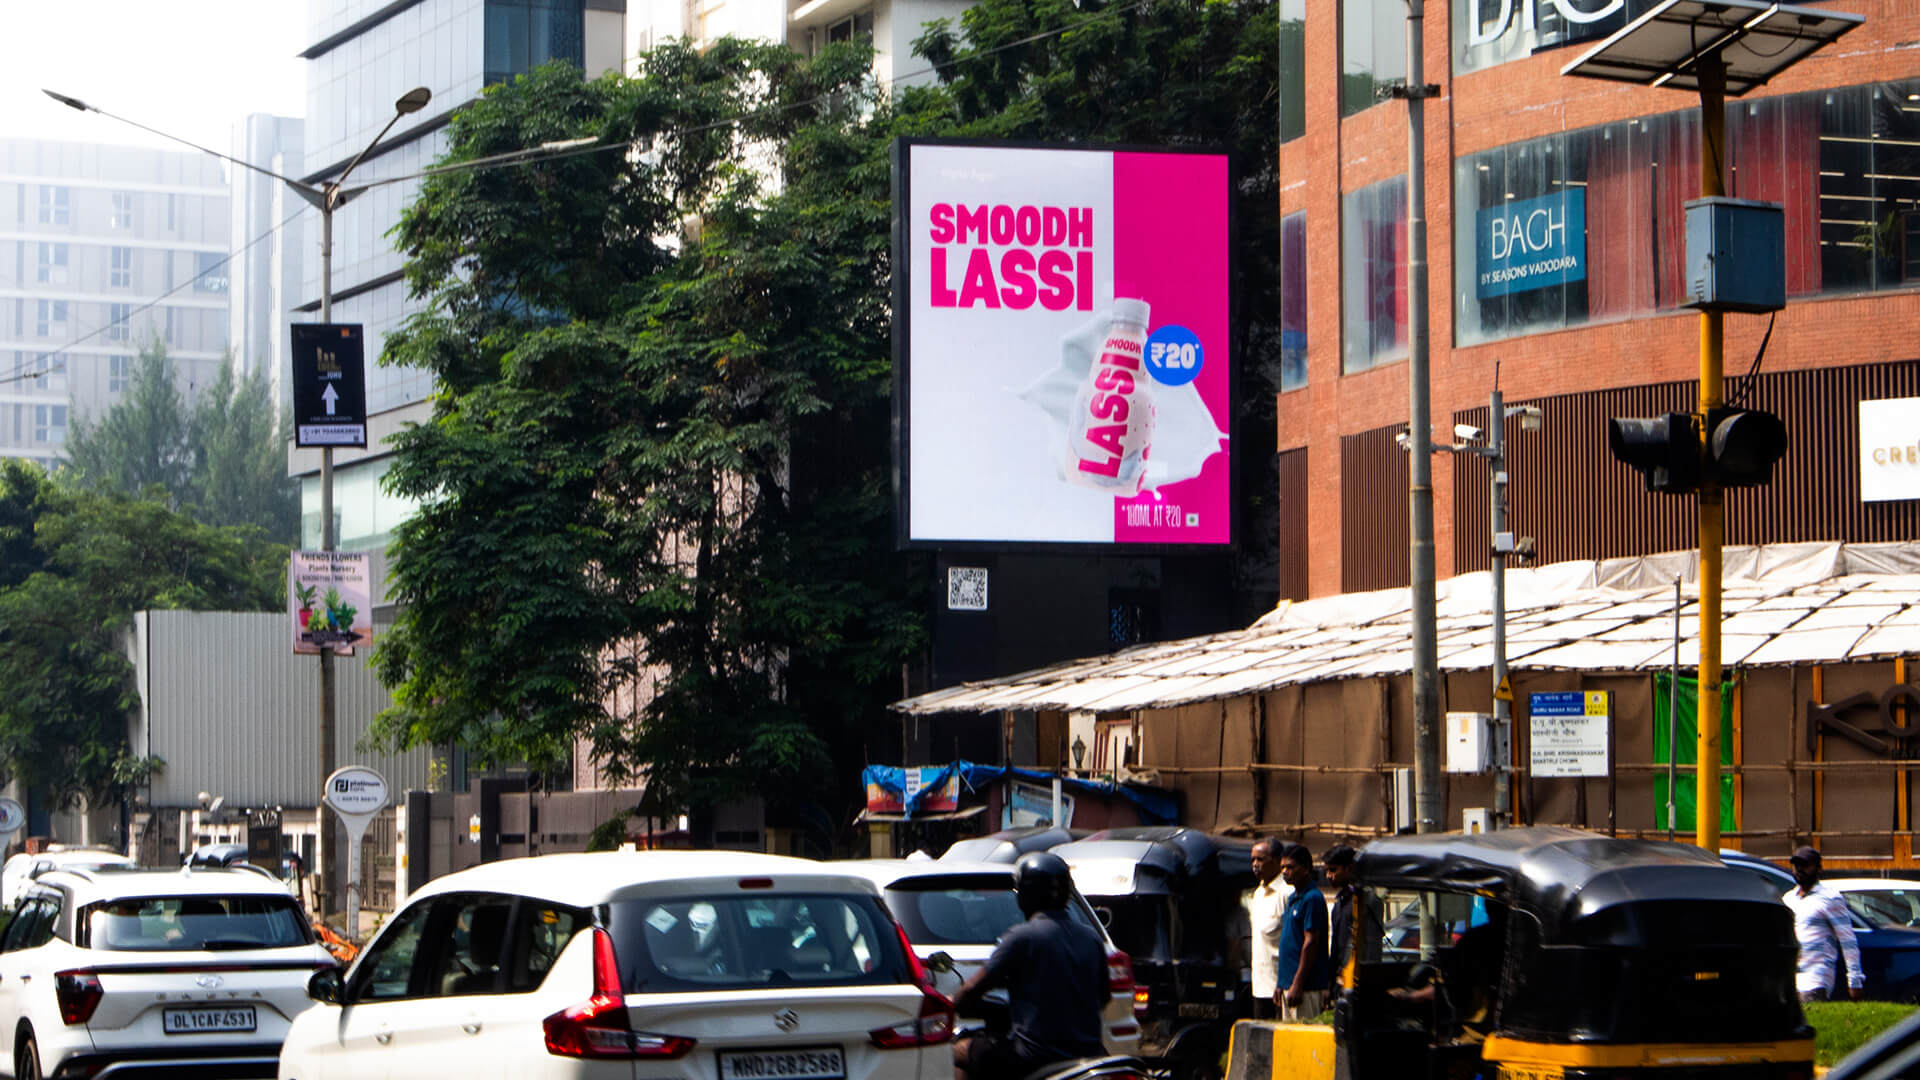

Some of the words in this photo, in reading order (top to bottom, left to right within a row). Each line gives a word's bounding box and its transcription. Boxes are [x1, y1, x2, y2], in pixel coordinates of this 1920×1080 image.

[930, 203, 1093, 248] SMOODH
[930, 247, 1093, 312] LASSI
[1481, 273, 1490, 285] BY
[1492, 265, 1527, 283] SEASONS
[1529, 256, 1577, 276] VADODARA
[1105, 338, 1141, 354] SMOODH
[1078, 352, 1140, 478] LASSI
[1153, 505, 1163, 527] AT
[301, 553, 329, 562] FRIENDS
[331, 553, 362, 562] FLOWERS
[174, 1012, 253, 1028] DL1CAF4531
